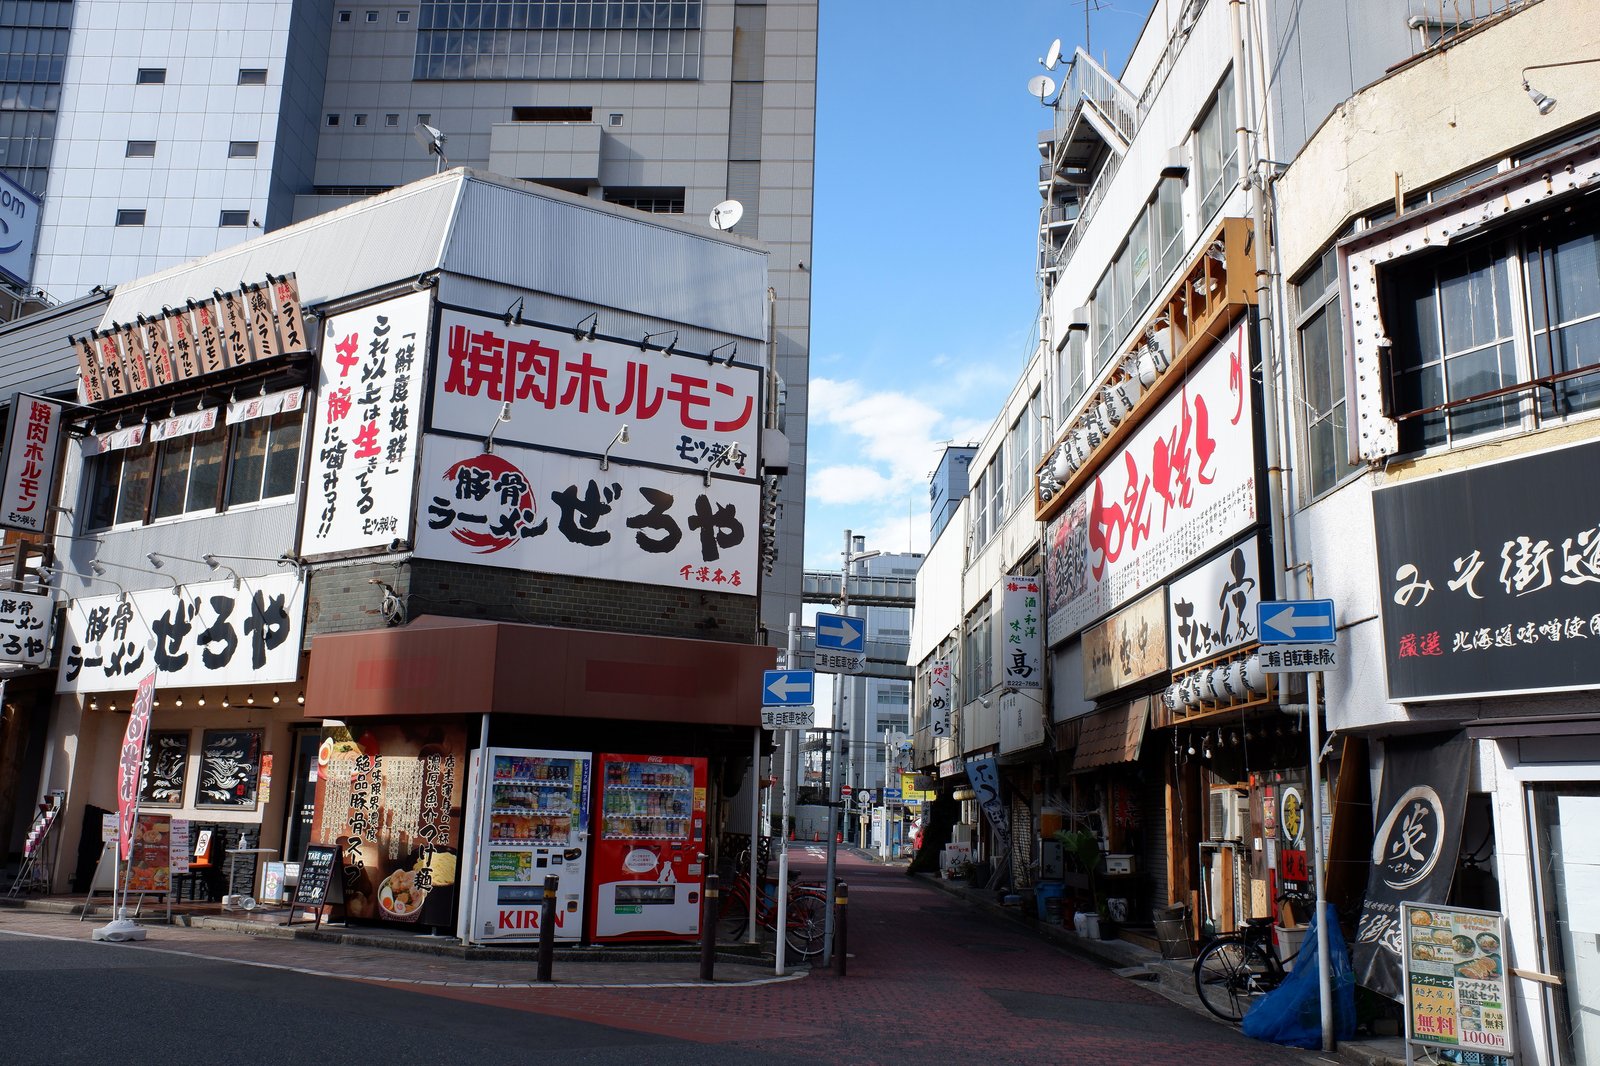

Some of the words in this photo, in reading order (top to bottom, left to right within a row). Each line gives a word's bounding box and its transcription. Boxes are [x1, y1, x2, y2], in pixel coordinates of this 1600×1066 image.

[0, 188, 25, 219] om
[226, 302, 246, 365] 中落ちカルビ
[251, 291, 271, 355] 鶏ハラミ
[283, 302, 301, 347] ライス
[148, 326, 166, 385] 牛タン刺し
[177, 338, 193, 377] 豚カルビ
[202, 326, 219, 371] ホルモン
[107, 361, 124, 396] 豚足
[445, 325, 753, 432] 焼肉ホルモン
[352, 315, 390, 515] これ以上は生きてる
[385, 332, 417, 475] 「鮮度抜群」
[16, 400, 51, 512] 焼肉ホルモン
[456, 466, 527, 506] 豚骨
[428, 496, 548, 539] ラーメン
[551, 478, 745, 561] ぜろや
[680, 564, 742, 587] 千葉本店
[1007, 582, 1039, 593] 梅一輪
[0, 599, 33, 615] 豚骨
[85, 600, 134, 643] 豚骨
[1024, 596, 1037, 639] 酒・和洋
[1174, 548, 1255, 663] きんちゃん家
[151, 588, 290, 673] ぜろや
[1009, 619, 1021, 644] 味処
[1399, 631, 1443, 659] 厳選
[66, 643, 145, 682] ラーメン
[816, 653, 865, 670] 二輪・自転車を除く
[1261, 648, 1336, 668] 二輪・自転車を除く
[762, 711, 814, 725] 二輪・自転車を除く
[933, 696, 945, 735] めら
[366, 754, 383, 843] 旨味限界濃度
[437, 754, 456, 845] 店主渾身の一杯
[344, 755, 372, 887] 絶品豚骨スープ
[414, 755, 442, 893] 濃厚魚介つけ麺
[1389, 802, 1429, 861] 炎
[308, 852, 320, 860] TAKE
[498, 910, 565, 929] KIRN
[1458, 981, 1500, 992] ランチタイム
[1458, 989, 1500, 1001] 限定セット
[1417, 1014, 1455, 1035] 無料
[1462, 1030, 1504, 1047] 1000円
[1485, 1019, 1504, 1031] 無料
